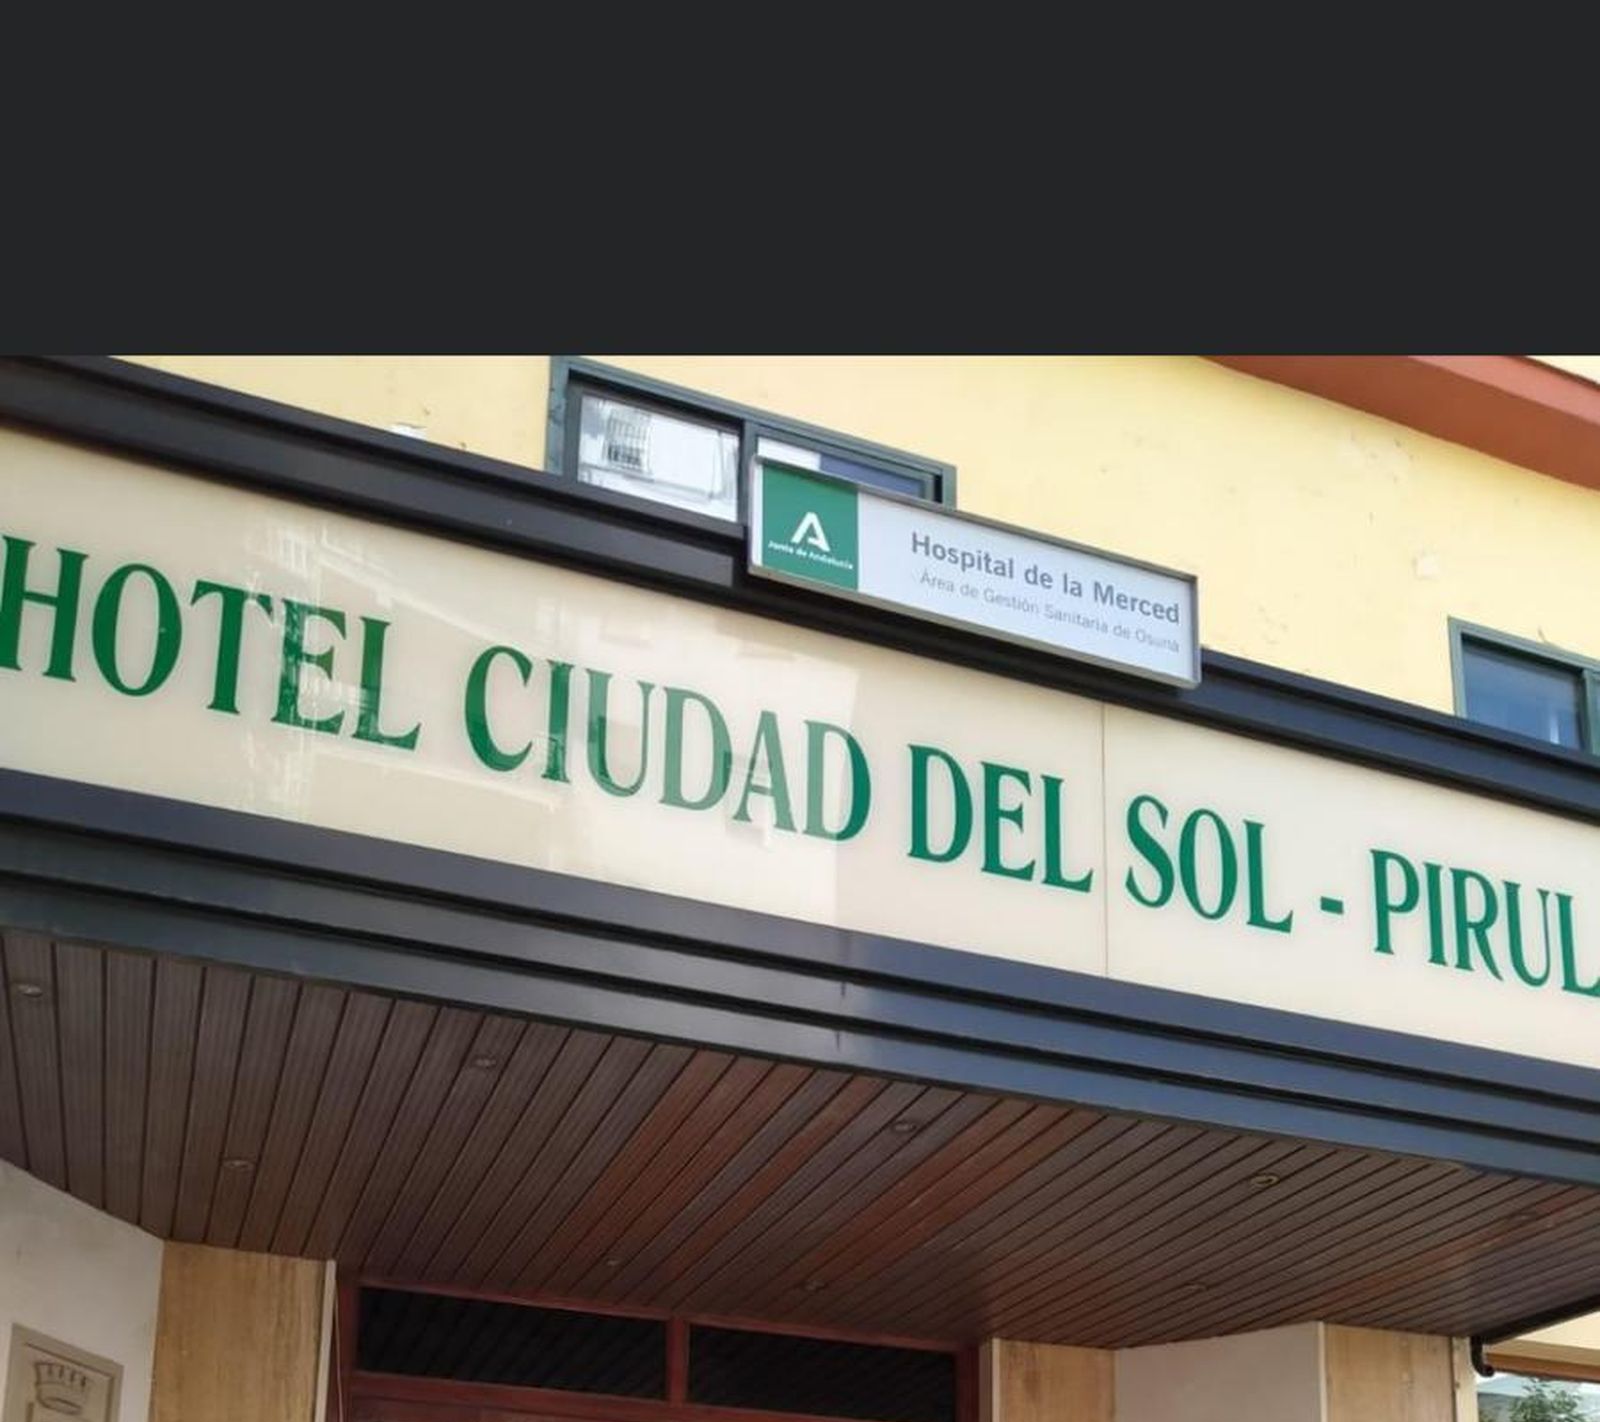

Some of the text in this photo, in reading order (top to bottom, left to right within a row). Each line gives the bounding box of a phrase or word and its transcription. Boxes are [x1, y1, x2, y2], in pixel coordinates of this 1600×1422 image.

[911, 531, 1180, 624] Hospital de la Merced
[920, 570, 955, 594] Área
[960, 583, 979, 600] de
[983, 587, 1040, 615] Gestión
[1044, 604, 1109, 634] Sanitaria
[1113, 623, 1132, 640] de
[0, 535, 420, 752] HOTEL
[463, 646, 873, 844] CIUDAD
[908, 744, 1095, 896] DEL
[1123, 794, 1294, 937] SOL
[1369, 848, 1600, 998] PIRUL
